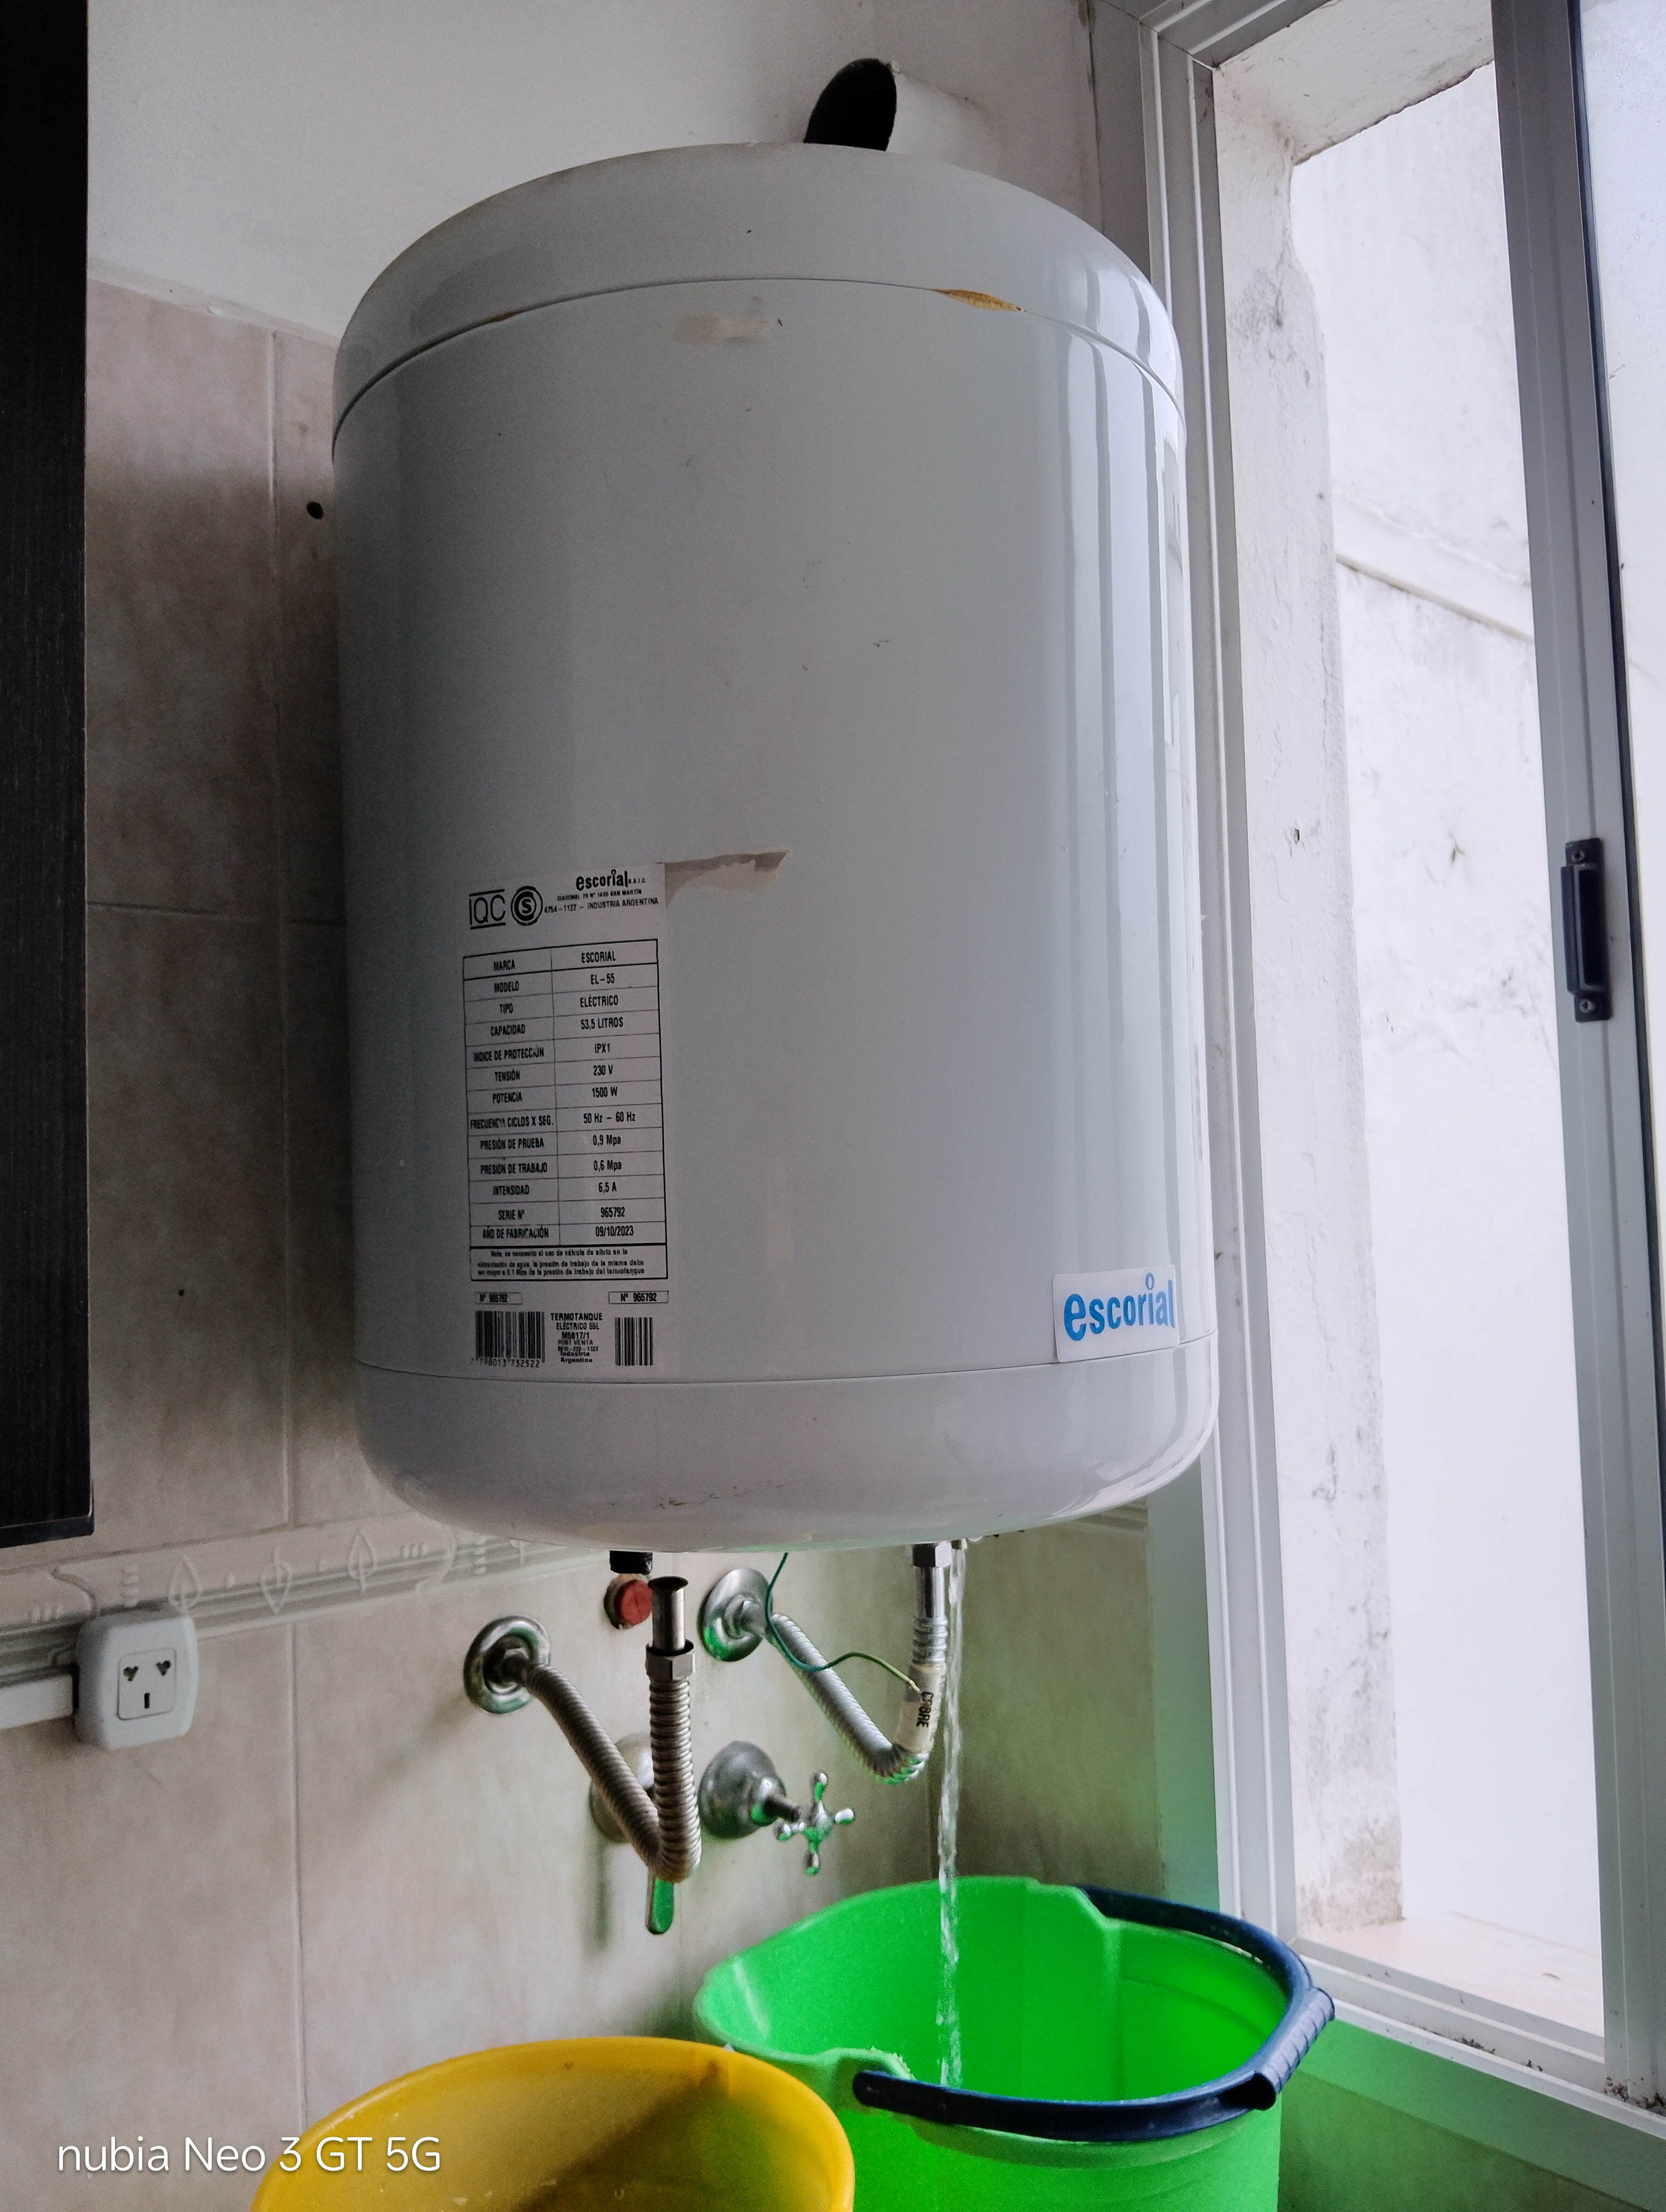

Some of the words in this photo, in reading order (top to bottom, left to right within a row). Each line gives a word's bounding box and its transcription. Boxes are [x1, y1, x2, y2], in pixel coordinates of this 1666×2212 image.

[576, 869, 629, 891] escorial
[587, 900, 620, 910] INDUSTRIA
[622, 897, 658, 906] ARGENTINA
[581, 950, 616, 963] ESCORIAL
[494, 960, 515, 971] MARCA
[494, 981, 519, 993] MODELO
[580, 995, 618, 1008] ELÉCTRICO
[499, 1003, 513, 1014] TIPO
[581, 1019, 595, 1030] 53,5
[598, 1017, 623, 1028] LITROS
[490, 1024, 526, 1036] CAPACIDAD
[594, 1043, 610, 1053] IPX1
[494, 1050, 502, 1060] DE
[495, 1069, 521, 1082] TENSIÓN
[593, 1065, 606, 1076] 230
[608, 1065, 613, 1074] V
[492, 1092, 522, 1103] POTENCIA
[592, 1088, 608, 1098] 1500
[611, 1086, 618, 1096] W
[507, 1116, 529, 1127] CICLOS
[531, 1116, 536, 1126] X
[539, 1115, 554, 1126] SEG.
[584, 1113, 592, 1124] 50
[594, 1113, 603, 1123] Hz
[616, 1111, 624, 1122] 60
[626, 1111, 636, 1122] Hz
[480, 1137, 505, 1150] PRESIÓN
[508, 1139, 516, 1149] DE
[518, 1137, 544, 1148] PRUEBA
[593, 1135, 604, 1146] 0,9
[606, 1135, 621, 1146] Mpa
[508, 1163, 516, 1174] DE
[518, 1162, 548, 1173] TRABAJO
[594, 1160, 605, 1171] 0,6
[607, 1160, 621, 1171] Mpa
[493, 1185, 529, 1195] INTENSIDAD
[598, 1182, 610, 1193] 6,5
[612, 1182, 617, 1192] A
[498, 1210, 516, 1220] SERIE
[600, 1206, 625, 1218] 965792
[496, 1229, 504, 1239] DE
[595, 1226, 634, 1237] 09/10/2023
[570, 1259, 589, 1269] trabajo
[574, 1268, 594, 1276] trabajo
[607, 1268, 645, 1276] termotanque
[633, 1291, 657, 1302] 965792
[1064, 1272, 1175, 1341] escorial
[550, 1313, 603, 1321] TERMOTANQUE
